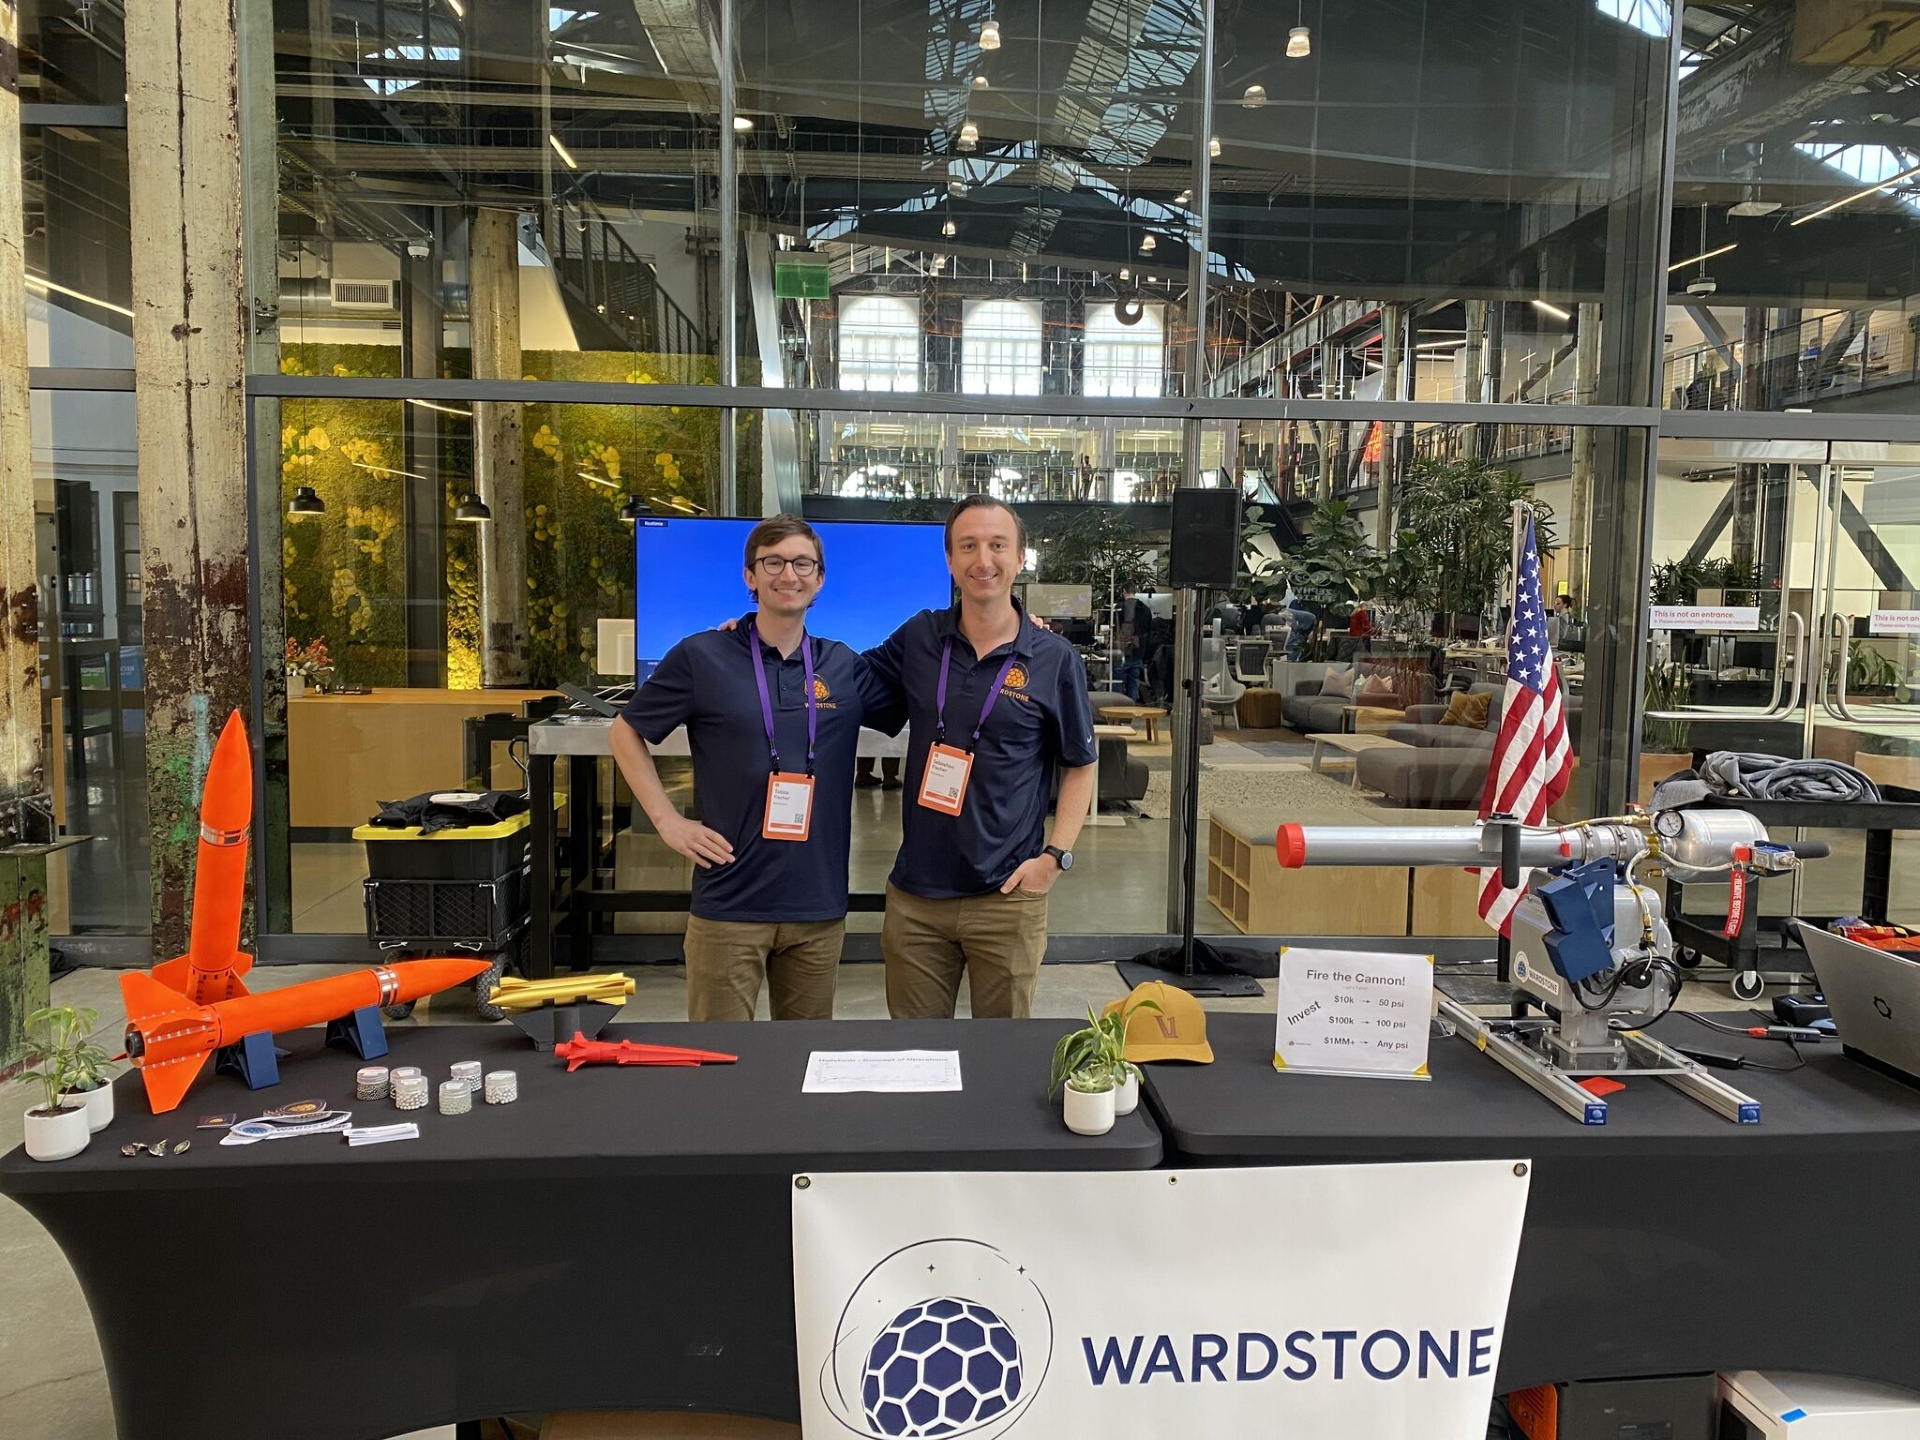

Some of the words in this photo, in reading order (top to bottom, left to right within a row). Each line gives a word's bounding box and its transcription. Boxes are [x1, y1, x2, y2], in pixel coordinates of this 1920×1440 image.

[1654, 610, 1668, 618] This
[1306, 970, 1329, 981] Fire
[1332, 971, 1352, 982] the
[1355, 973, 1406, 986] Cannon!
[1529, 970, 1558, 993] WARDSTONE
[1334, 995, 1354, 1004] $10k
[1378, 998, 1389, 1007] 50
[1391, 1000, 1404, 1009] psi
[1287, 1000, 1322, 1026] Invest
[1328, 1016, 1354, 1025] $100k
[1376, 1019, 1391, 1028] 100
[1393, 1021, 1406, 1029] psi
[1324, 1036, 1355, 1046] $1MM+
[1377, 1040, 1394, 1050] Any
[1396, 1041, 1408, 1050] psi
[1081, 1326, 1495, 1386] WARDSTONE
